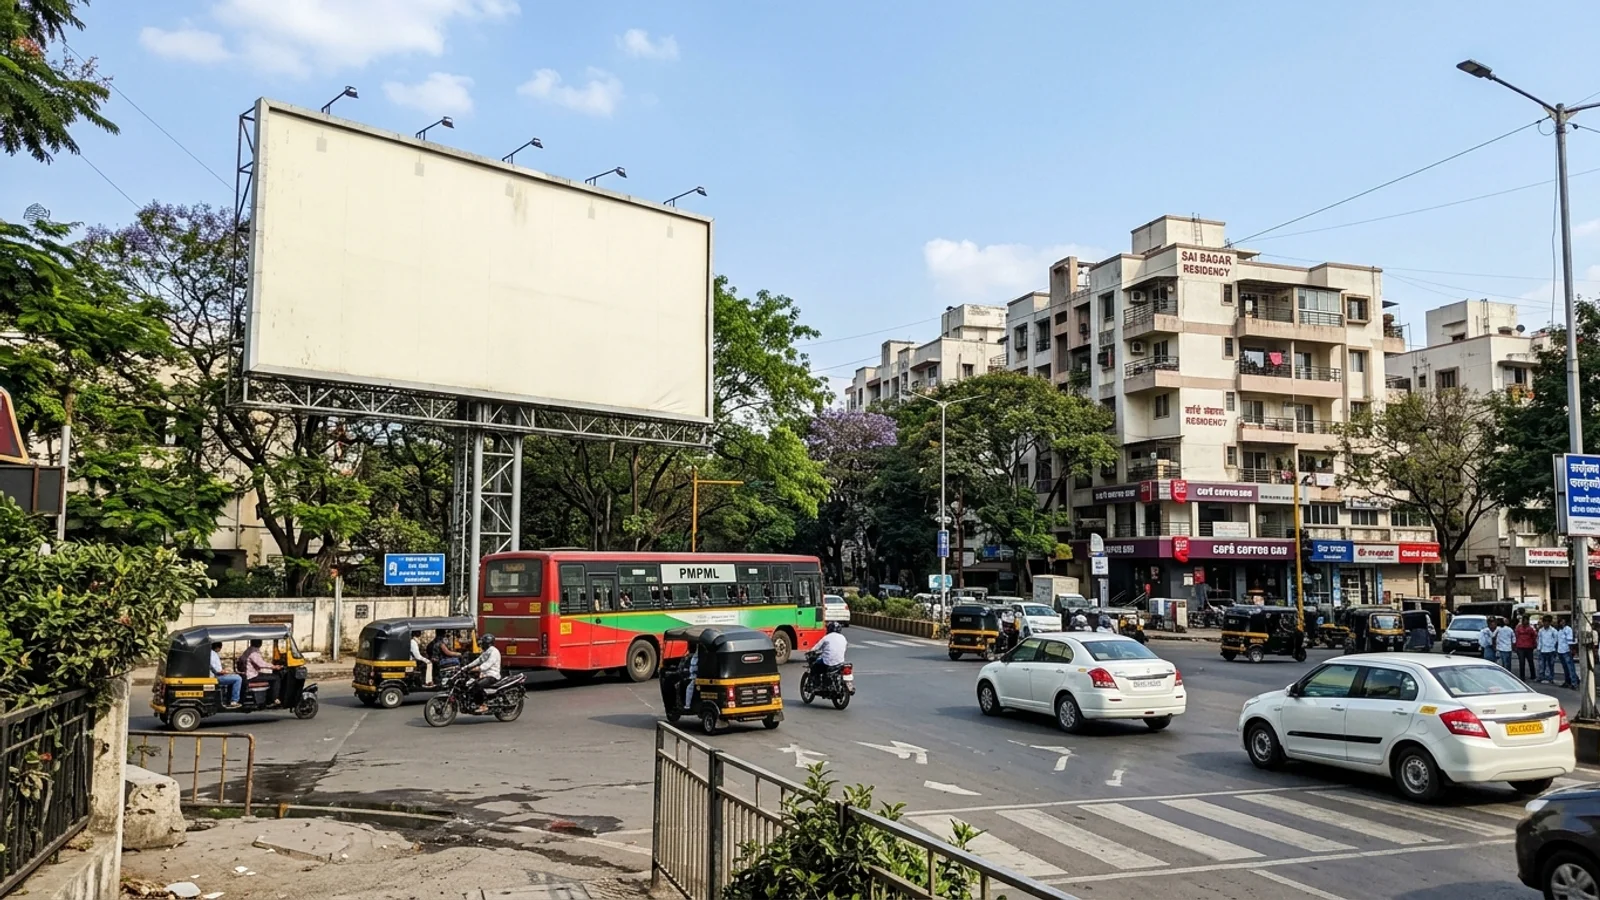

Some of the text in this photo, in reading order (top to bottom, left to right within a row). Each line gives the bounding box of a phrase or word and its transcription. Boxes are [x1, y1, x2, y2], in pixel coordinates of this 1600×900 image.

[1181, 251, 1197, 262] SAI
[1183, 264, 1230, 277] RESIDENCY
[679, 567, 720, 579] PMPML
